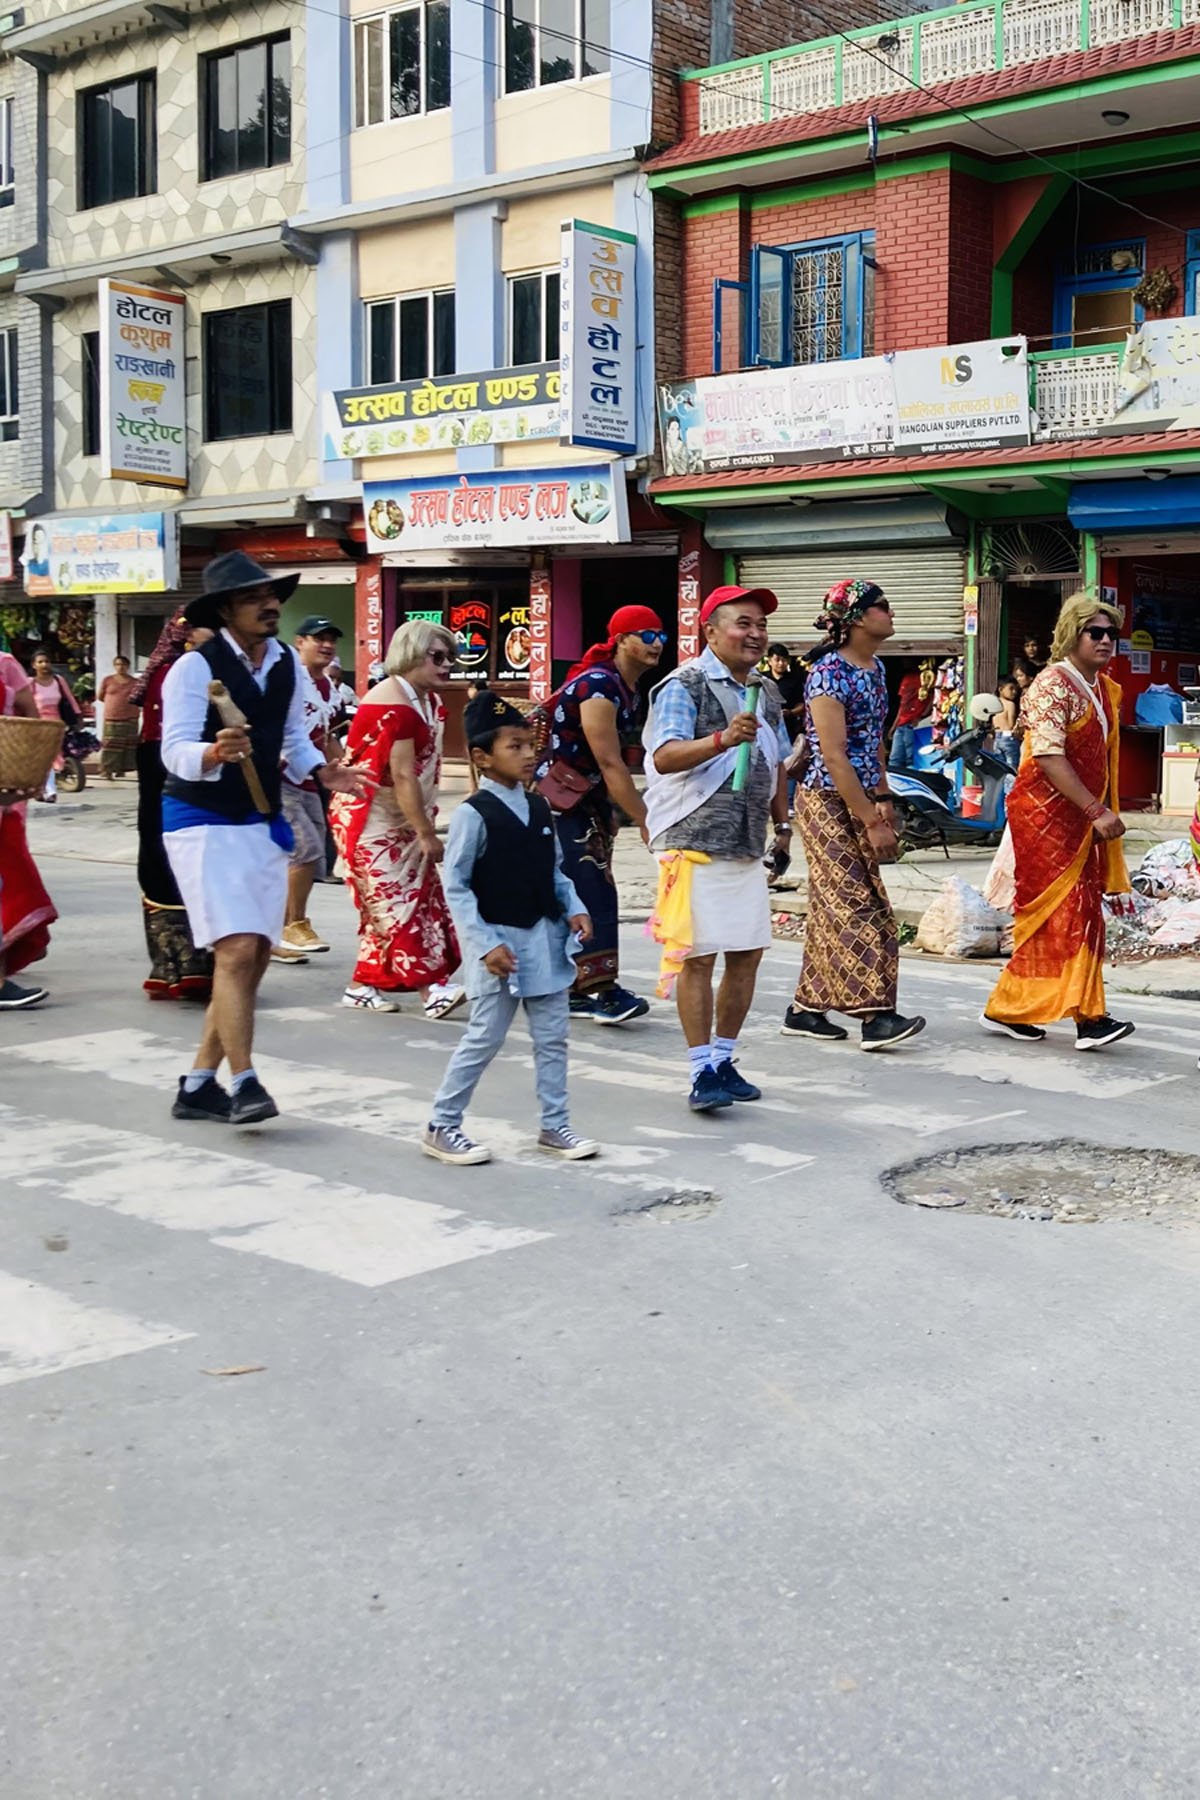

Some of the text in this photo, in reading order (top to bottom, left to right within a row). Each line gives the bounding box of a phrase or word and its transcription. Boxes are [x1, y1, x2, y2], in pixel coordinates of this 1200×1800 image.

[116, 296, 172, 325] होटल
[119, 323, 172, 350] कुशुम
[587, 323, 622, 406] होटल
[343, 391, 406, 423] उत्सव
[412, 379, 480, 417] होटल
[486, 373, 540, 405] एण्ड
[945, 417, 988, 431] SUPPLIERS
[408, 476, 571, 528] उत्सव होटल एण्ड लज
[451, 603, 486, 625] होटल
